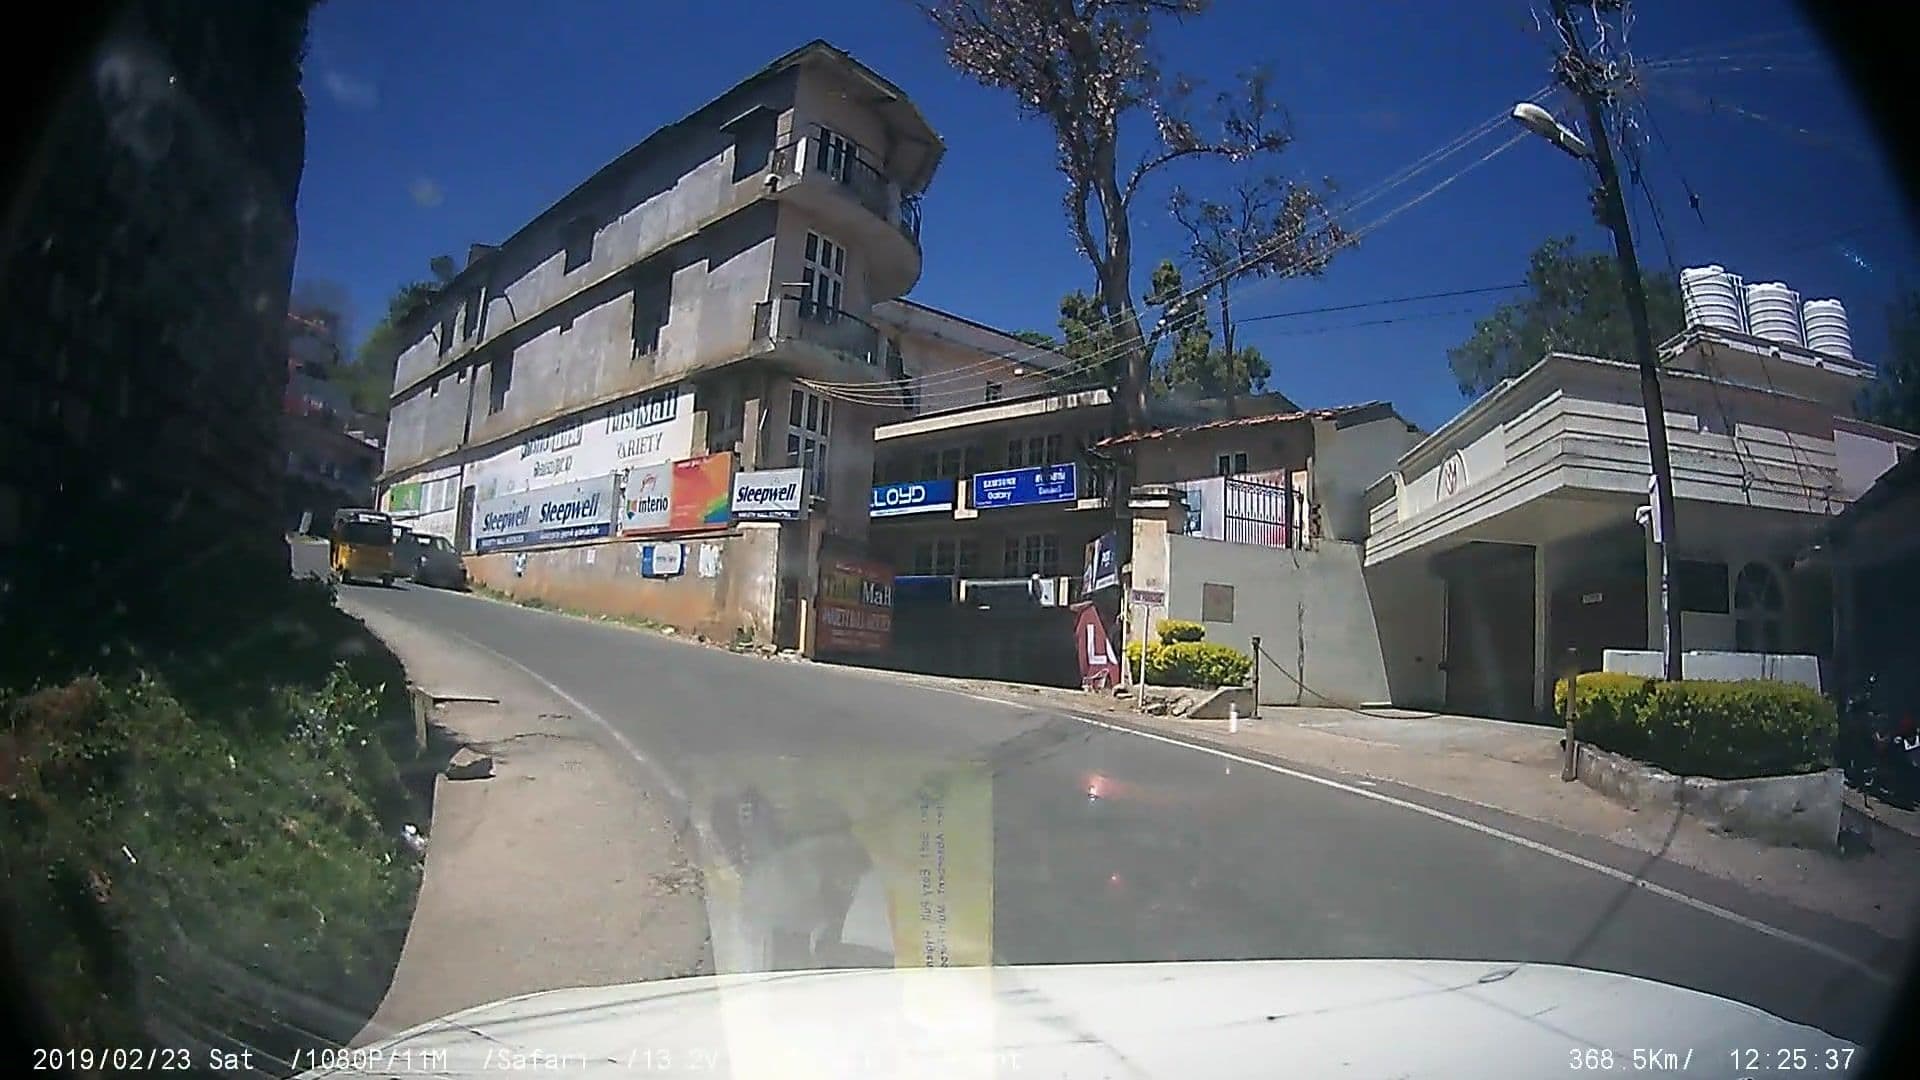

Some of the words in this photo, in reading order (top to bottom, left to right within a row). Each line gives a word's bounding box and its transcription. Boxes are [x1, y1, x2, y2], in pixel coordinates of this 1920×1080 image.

[638, 495, 669, 513] interio
[736, 483, 797, 504] Sleepwell
[870, 485, 926, 508] LOYD
[482, 505, 531, 533] Sleepwell
[539, 493, 601, 524] Sleepwell
